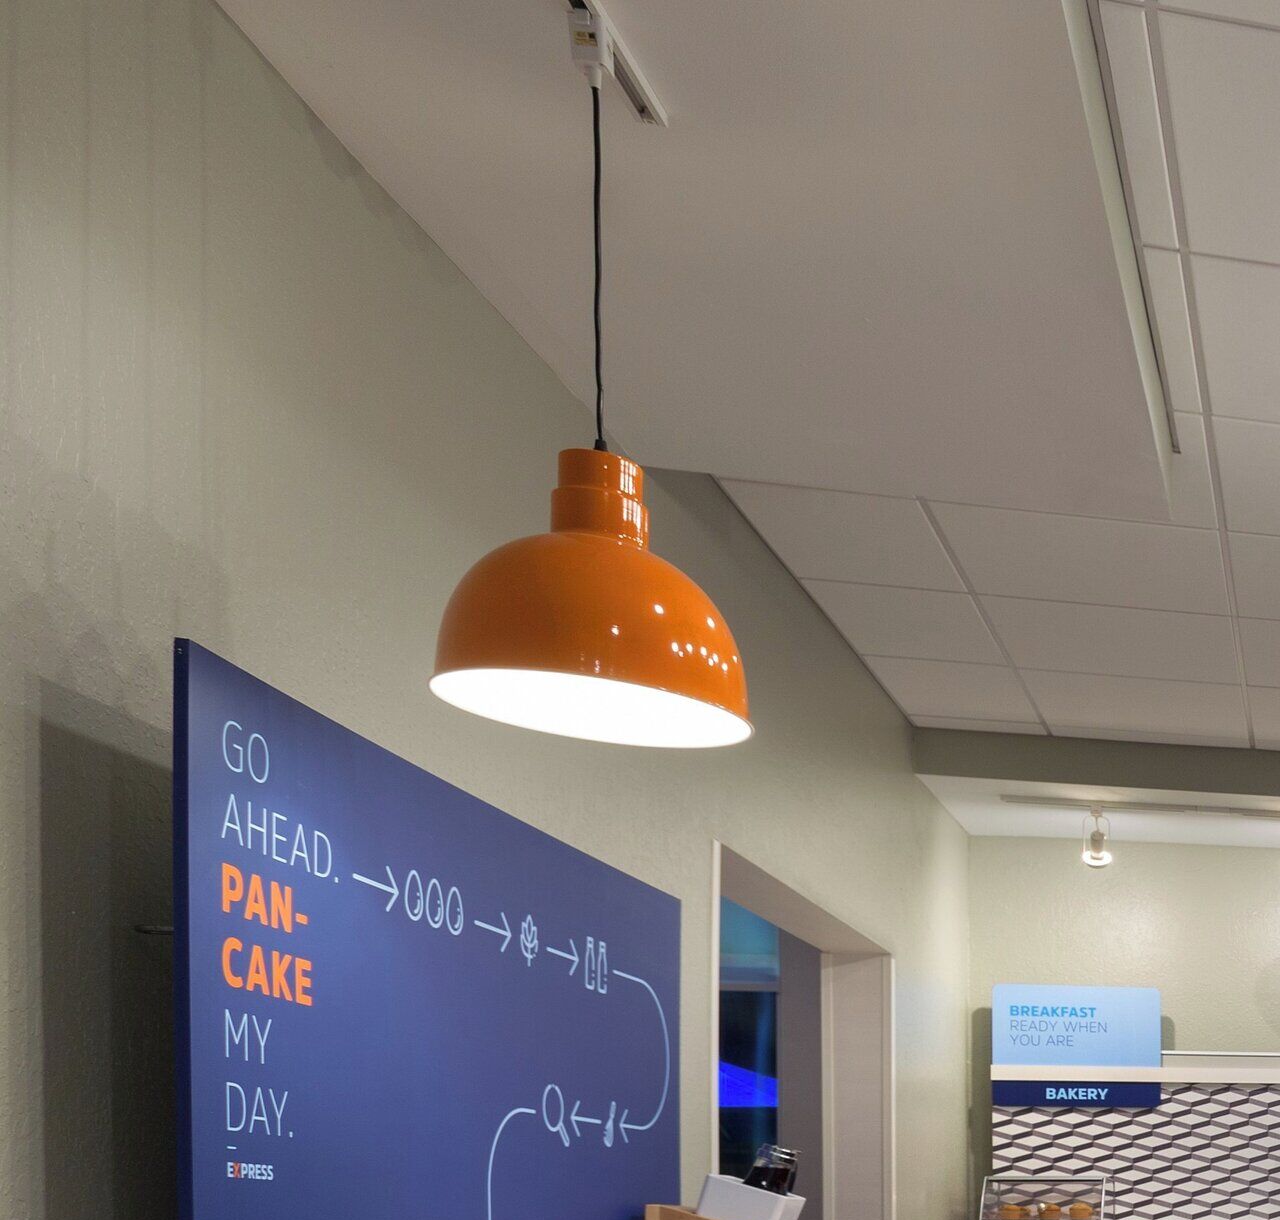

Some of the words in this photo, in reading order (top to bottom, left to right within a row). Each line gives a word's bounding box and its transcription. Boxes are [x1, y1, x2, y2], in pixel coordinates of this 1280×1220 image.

[221, 720, 270, 784] GO
[221, 793, 340, 884] AHEAD.
[221, 862, 309, 934] PAN-
[221, 936, 314, 1007] CAKE
[224, 1008, 272, 1065] MY
[1009, 1004, 1097, 1018] BREAKFAST
[1009, 1019, 1058, 1034] READY
[1063, 1020, 1108, 1034] WHEN
[1009, 1034, 1041, 1048] YOU
[1046, 1034, 1074, 1048] ARE
[225, 1081, 294, 1139] DAY.
[1045, 1087, 1109, 1101] BAKERY
[226, 1161, 275, 1182] EXPRESS
